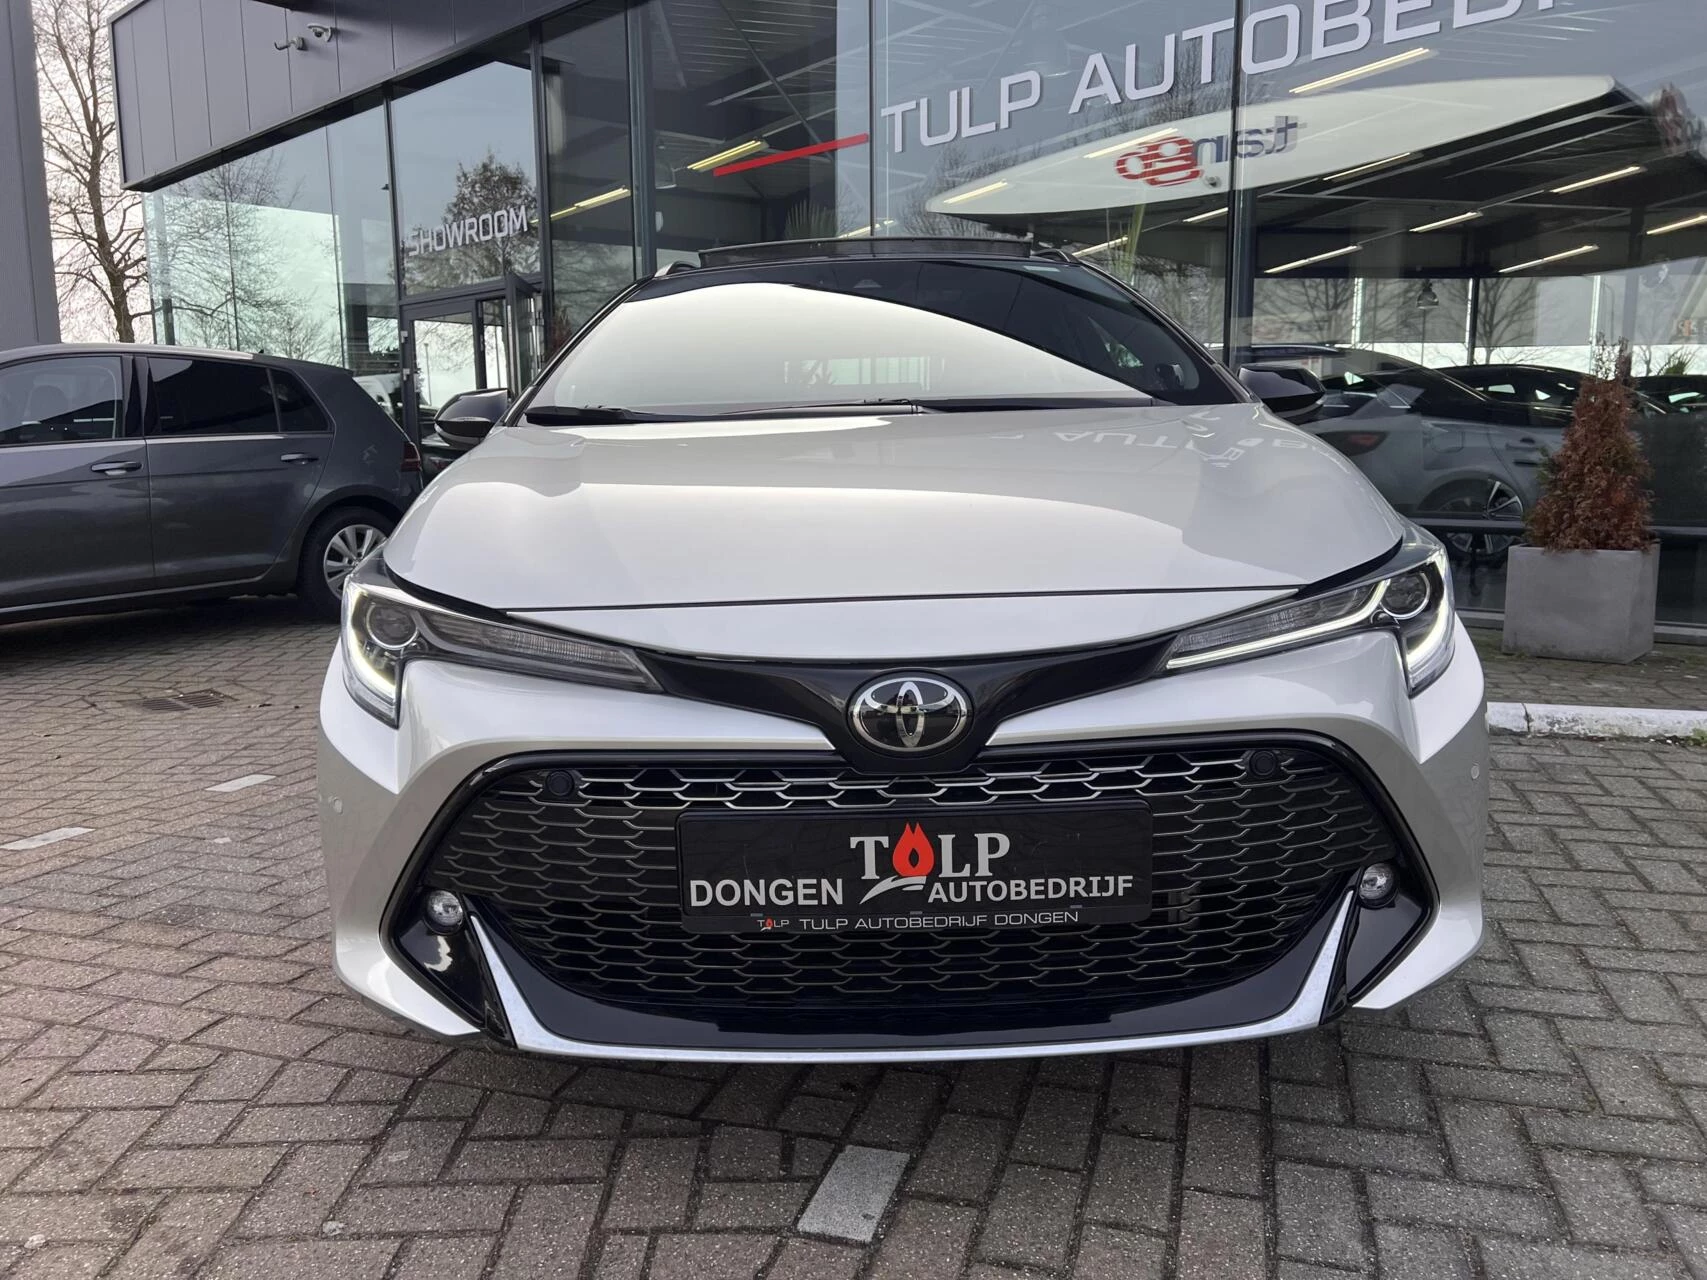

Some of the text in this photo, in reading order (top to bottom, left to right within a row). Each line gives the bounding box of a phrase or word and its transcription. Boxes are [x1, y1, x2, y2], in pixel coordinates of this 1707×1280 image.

[881, 0, 1555, 153] TULP AUTOBE
[408, 205, 528, 257] SHOWROOM
[690, 875, 1134, 908] DONGEN AUTOBEDRIJF
[800, 918, 848, 930] TULP
[855, 915, 987, 930] AUTOBEDRIJF
[994, 911, 1079, 926] DONGEN
